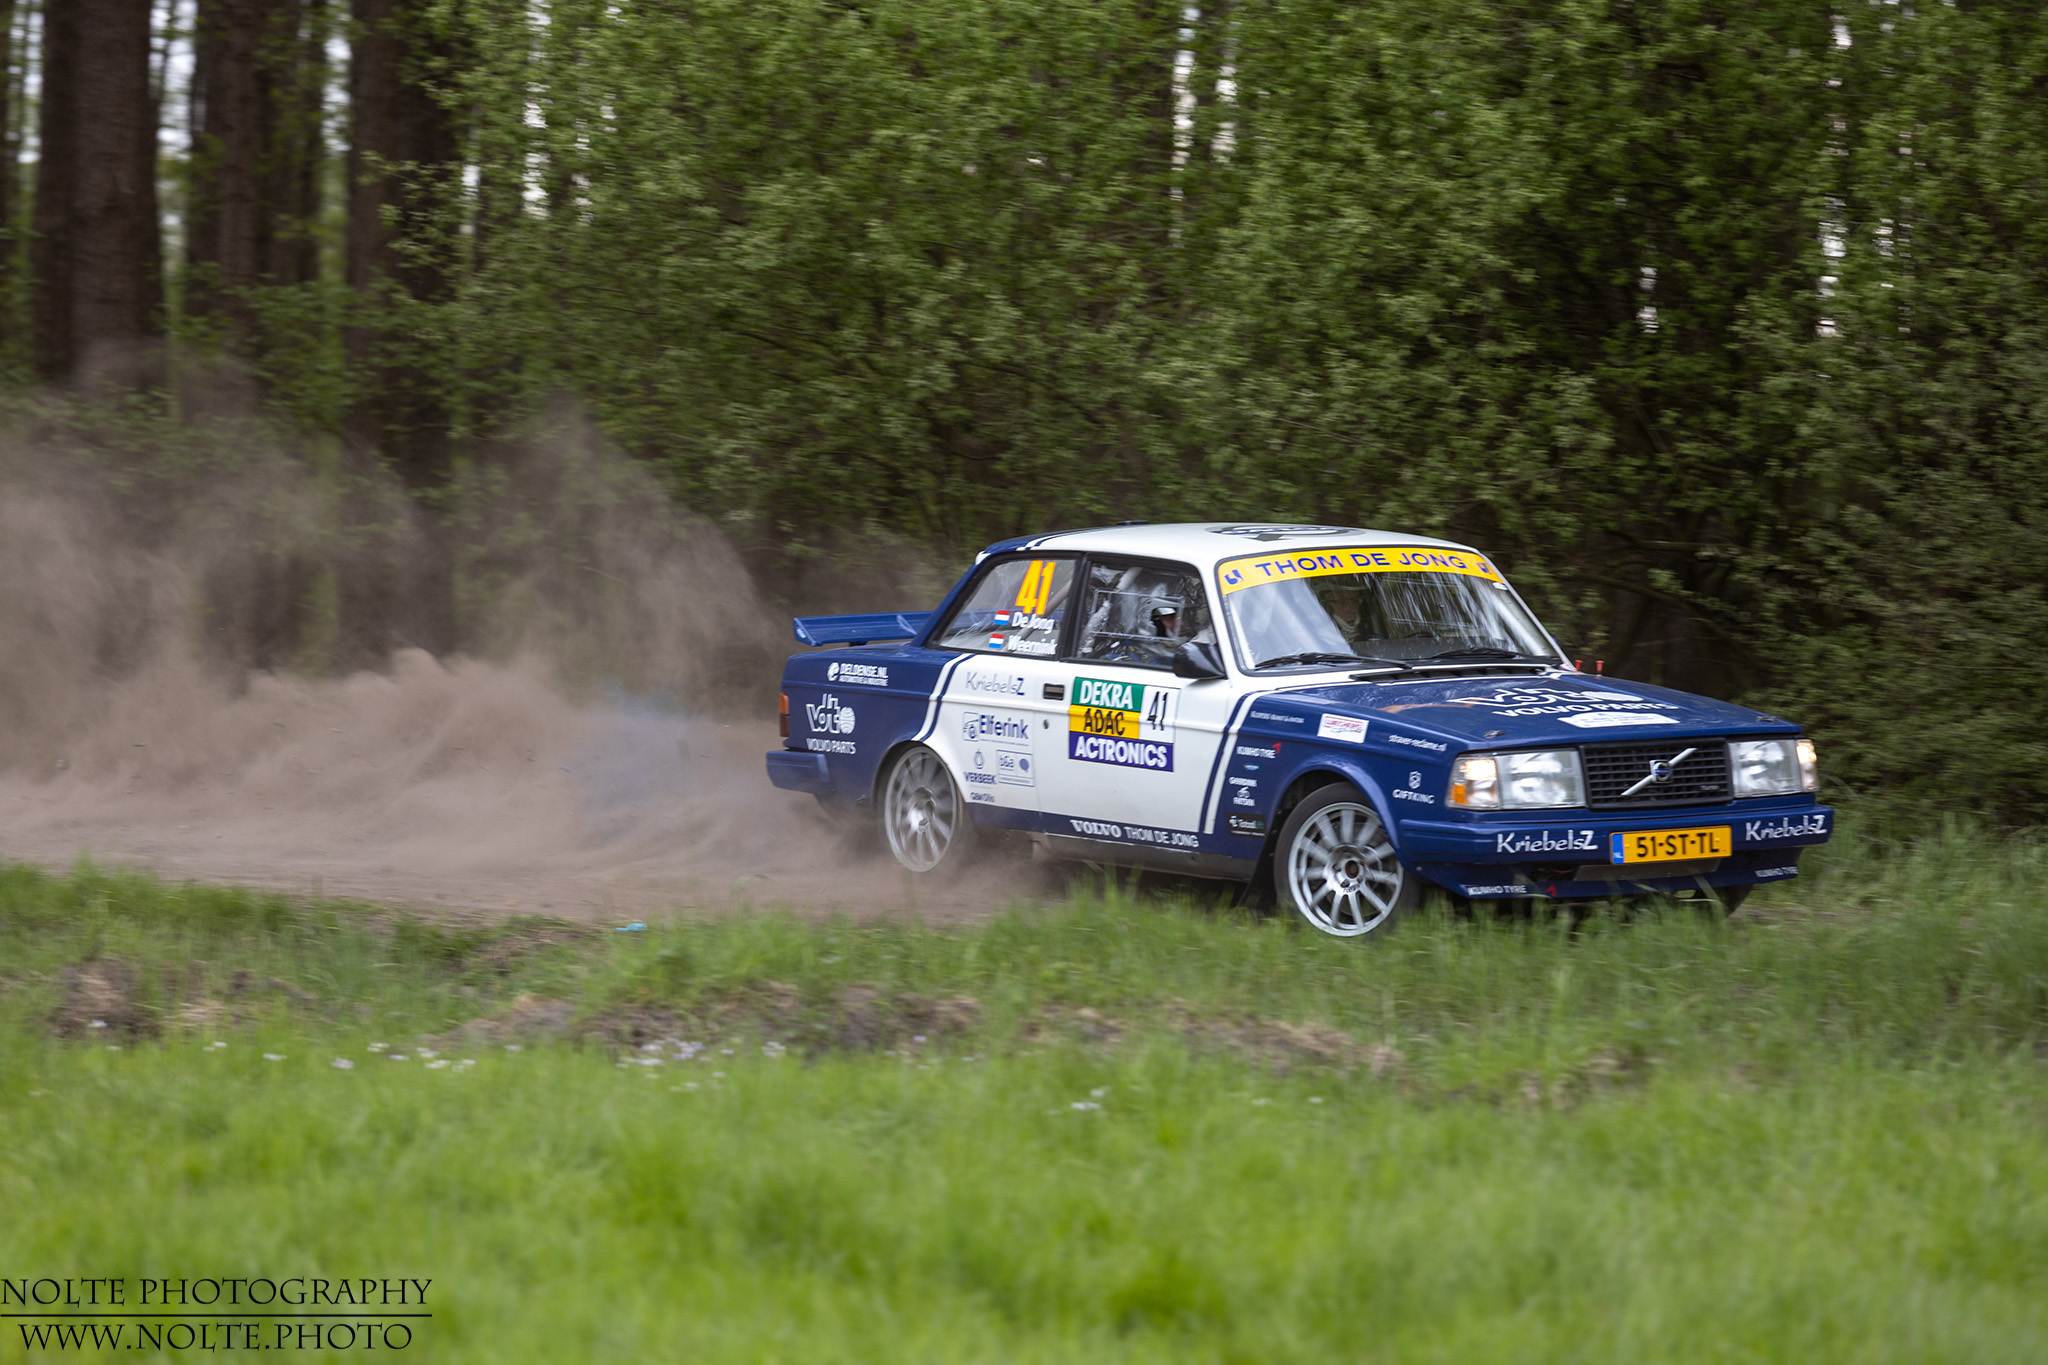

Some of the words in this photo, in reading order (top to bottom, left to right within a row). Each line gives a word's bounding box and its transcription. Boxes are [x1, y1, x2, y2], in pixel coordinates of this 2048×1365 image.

[1254, 554, 1344, 577] THOM
[1350, 552, 1390, 567] DE
[1398, 552, 1468, 570] JONG
[1015, 560, 1056, 615] 41
[965, 671, 1025, 696] KriebelsZ
[1079, 680, 1133, 709] DEKRA
[1083, 708, 1126, 736] ADAC
[1147, 691, 1169, 731] 41
[1493, 704, 1592, 717] VOLVO
[1590, 703, 1680, 711] PARTS
[979, 714, 1029, 740] Elferink
[806, 738, 831, 752] VOLVO
[831, 740, 856, 755] PARTS
[1074, 735, 1168, 768] ACTRONICS
[1070, 819, 1122, 838] VOLVO
[1123, 826, 1155, 842] THOM
[1154, 830, 1171, 844] DE
[1170, 832, 1200, 848] JONG
[1745, 814, 1828, 841] KriebelsZ
[1496, 829, 1598, 853] KriebelsZ
[1636, 832, 1719, 858] 51-ST-TL
[1467, 885, 1504, 896] KUMHO
[1503, 884, 1528, 894] TYRE
